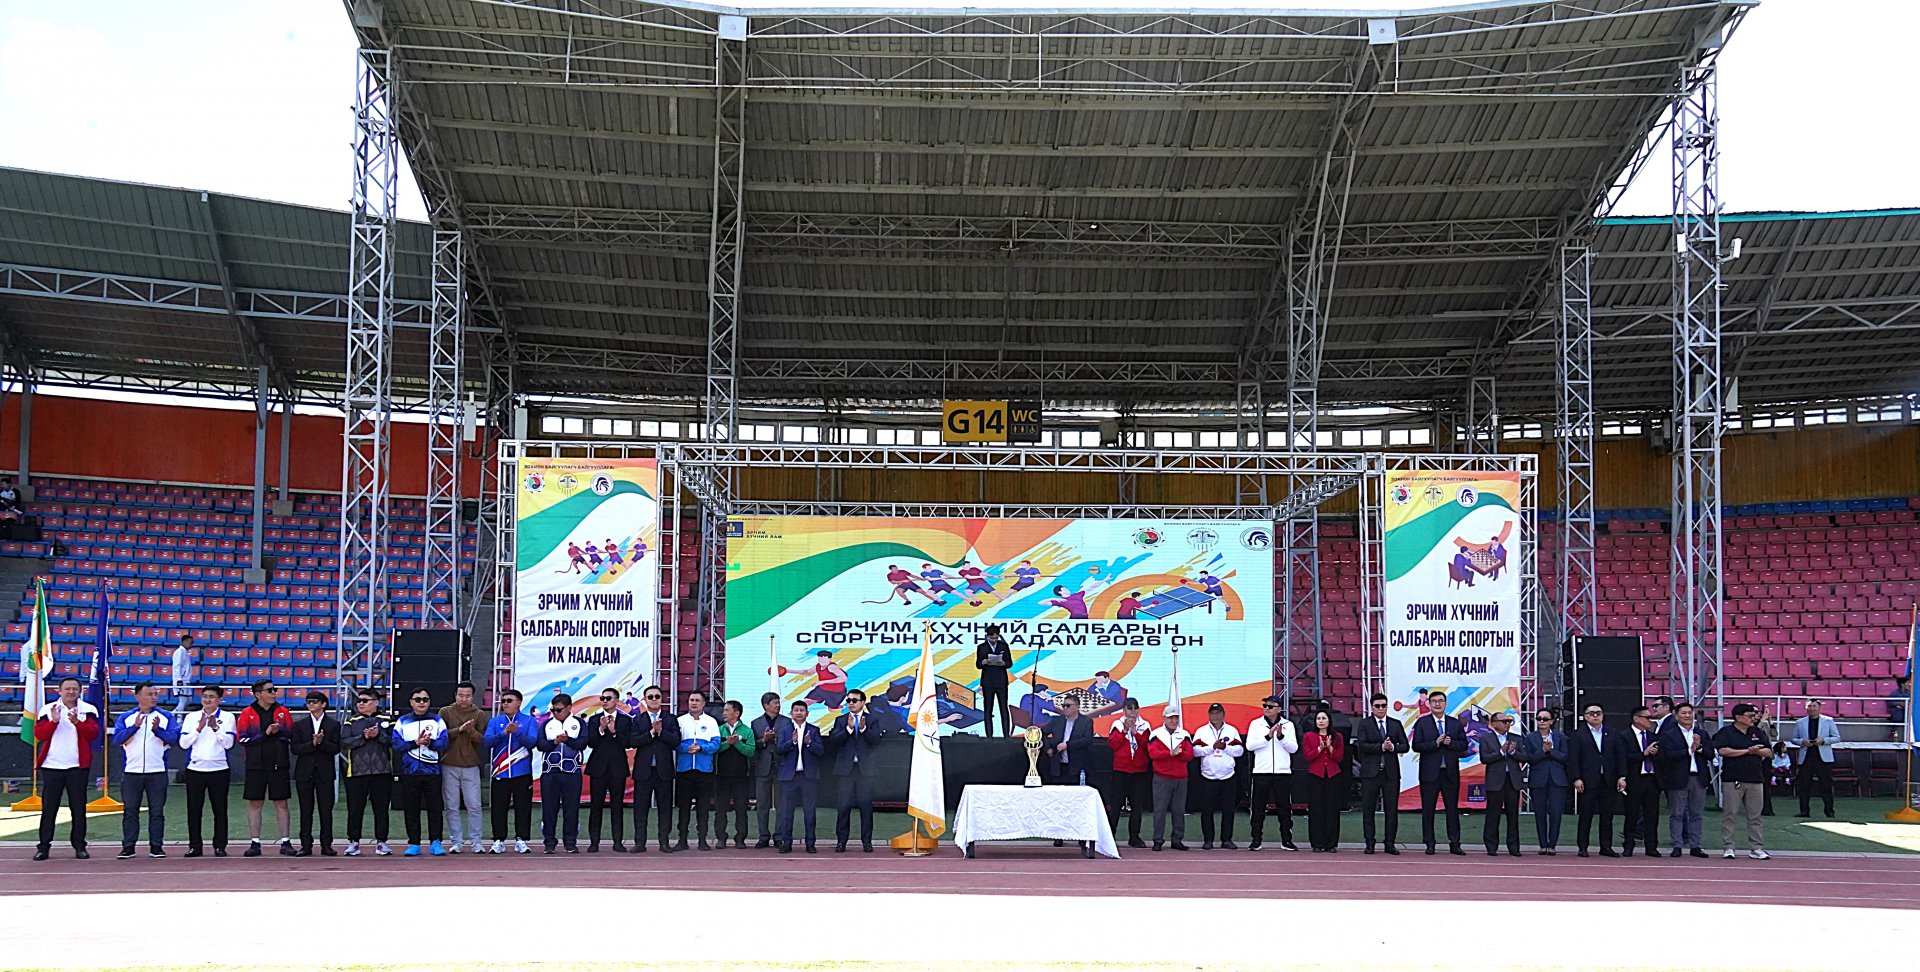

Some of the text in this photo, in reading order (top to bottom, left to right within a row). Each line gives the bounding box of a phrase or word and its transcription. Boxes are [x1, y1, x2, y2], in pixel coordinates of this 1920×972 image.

[948, 409, 1038, 434] G14 WC
[538, 591, 633, 611] ЭРЧИМ ХҮЧНИЙ
[1406, 601, 1499, 621] ЭРЧИМ ХҮЧНИЙ
[521, 619, 649, 638] САЛБАРЫН СПОРТЫН
[821, 621, 912, 632] ЭРЧИМ
[1037, 622, 1179, 635] САЛБАРЫН
[796, 632, 1204, 647] СПОРТЫН ИХ НАДАМ 2026 ОН
[1389, 630, 1514, 648] САЛБАРЫН СПОРТЫН
[548, 646, 621, 665] ИХ НААДАМ
[1417, 656, 1487, 675] ИХ НААДАМ
